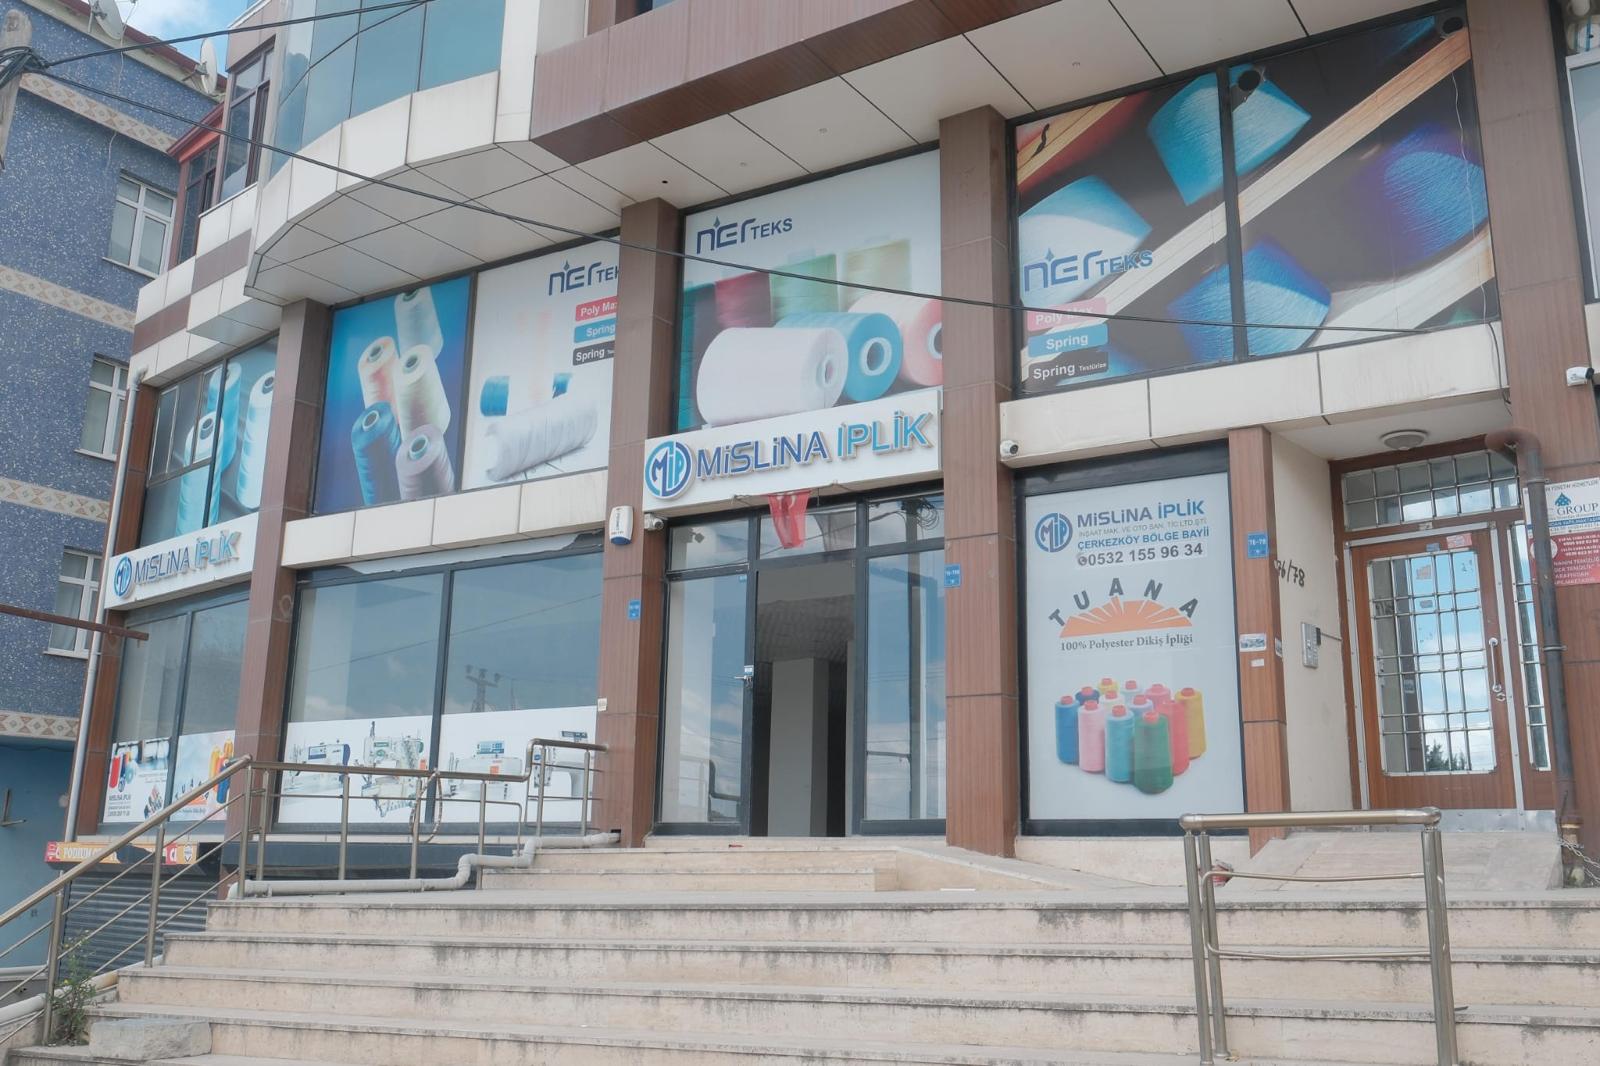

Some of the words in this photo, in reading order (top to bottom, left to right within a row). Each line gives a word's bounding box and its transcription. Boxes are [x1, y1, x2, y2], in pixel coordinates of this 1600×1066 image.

[580, 305, 600, 317] Poly
[1035, 310, 1064, 326] Poly
[586, 324, 615, 337] Spring
[1045, 334, 1089, 351] Spring
[575, 348, 605, 363] Spring
[1032, 363, 1076, 380] Spring
[1157, 498, 1205, 519] İPLİK
[1556, 502, 1599, 516] GROUP
[1077, 534, 1140, 551] ÇERKEZKÖY
[1142, 530, 1179, 543] BÖLGE
[1088, 551, 1124, 567] 0532
[1129, 548, 1156, 562] 155
[1161, 545, 1179, 559] 96
[1184, 542, 1203, 556] 34
[1061, 640, 1087, 651] 100%
[1089, 638, 1134, 651] Polyester
[1136, 635, 1164, 647] Dikiş
